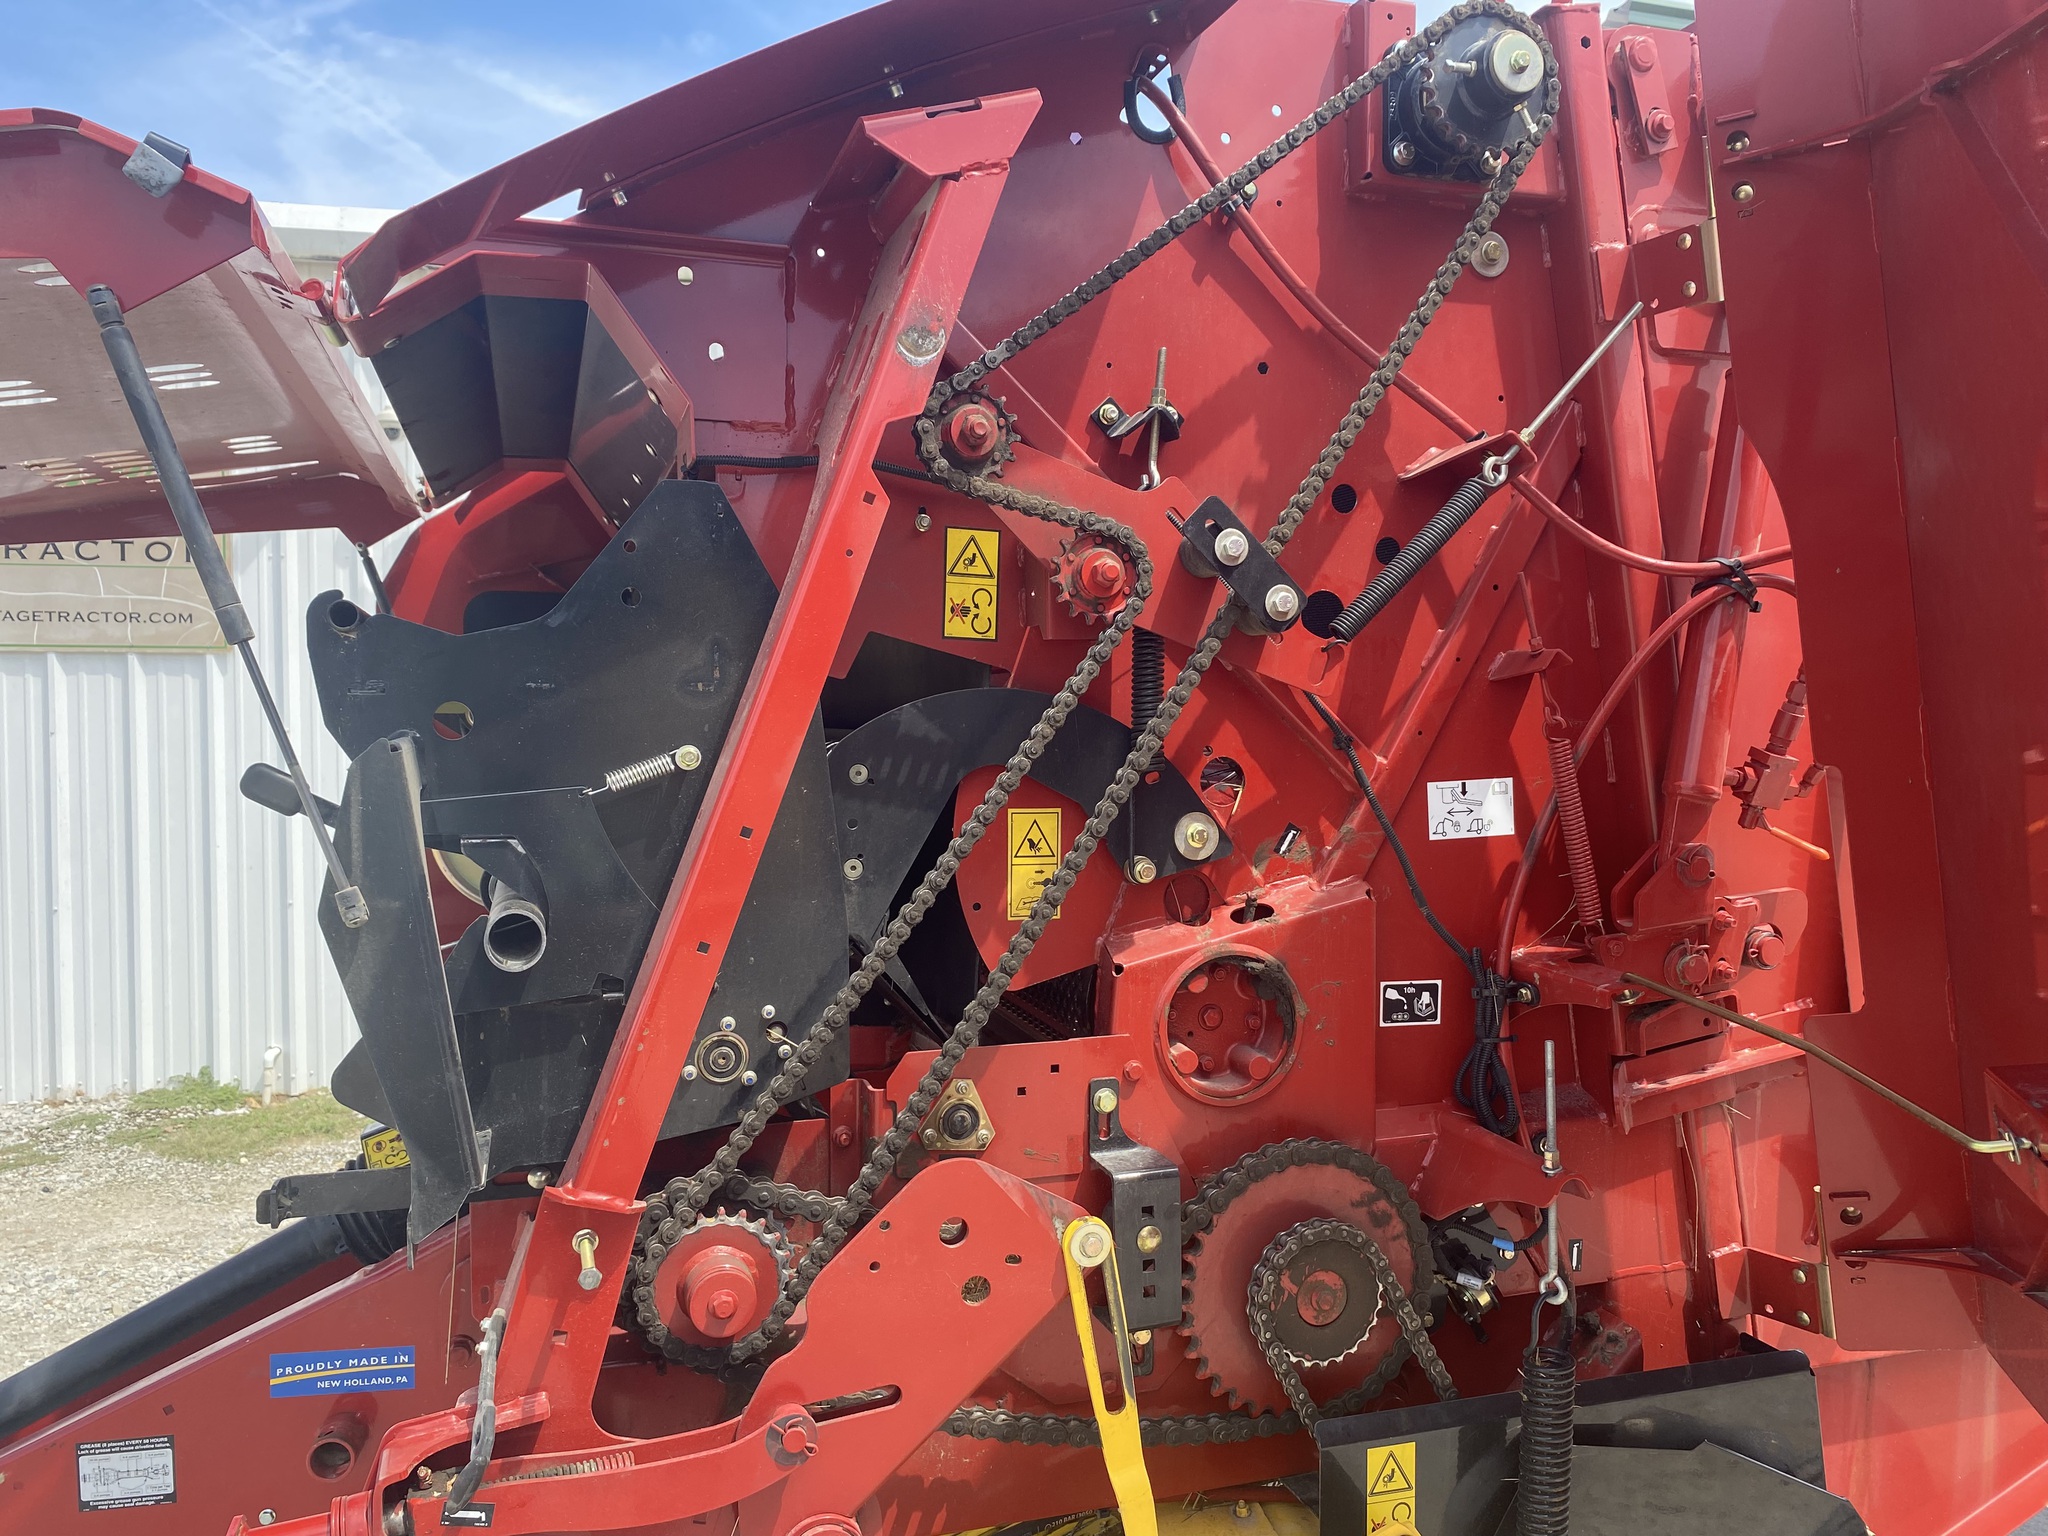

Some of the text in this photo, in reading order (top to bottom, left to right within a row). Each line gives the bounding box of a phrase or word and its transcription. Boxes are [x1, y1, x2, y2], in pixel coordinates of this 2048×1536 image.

[4, 540, 191, 562] RACTO
[0, 609, 193, 624] AGETRACTOR.COM
[1403, 986, 1416, 994] 10h
[276, 1354, 409, 1376] PROUDLY MADE IN
[317, 1375, 408, 1389] NEW HOLLAND, PA
[125, 1438, 143, 1446] EVERY
[1063, 1514, 1076, 1522] BAR
